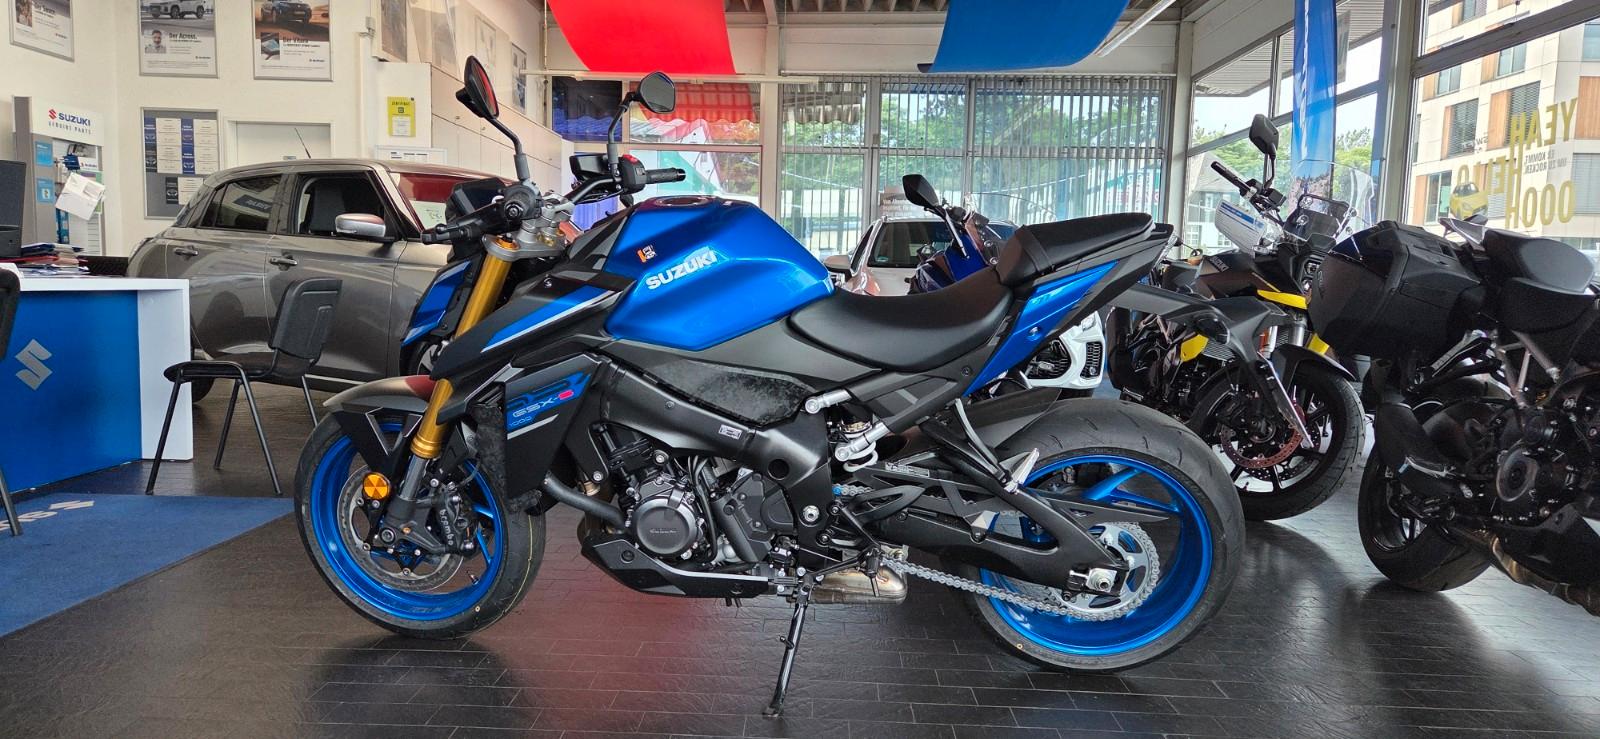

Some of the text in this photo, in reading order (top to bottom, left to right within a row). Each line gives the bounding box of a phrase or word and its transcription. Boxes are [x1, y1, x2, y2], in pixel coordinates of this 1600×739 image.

[58, 112, 91, 127] SUZUKI
[645, 249, 718, 290] SUZUKI
[509, 415, 533, 427] 1000
[439, 508, 454, 546] brembo
